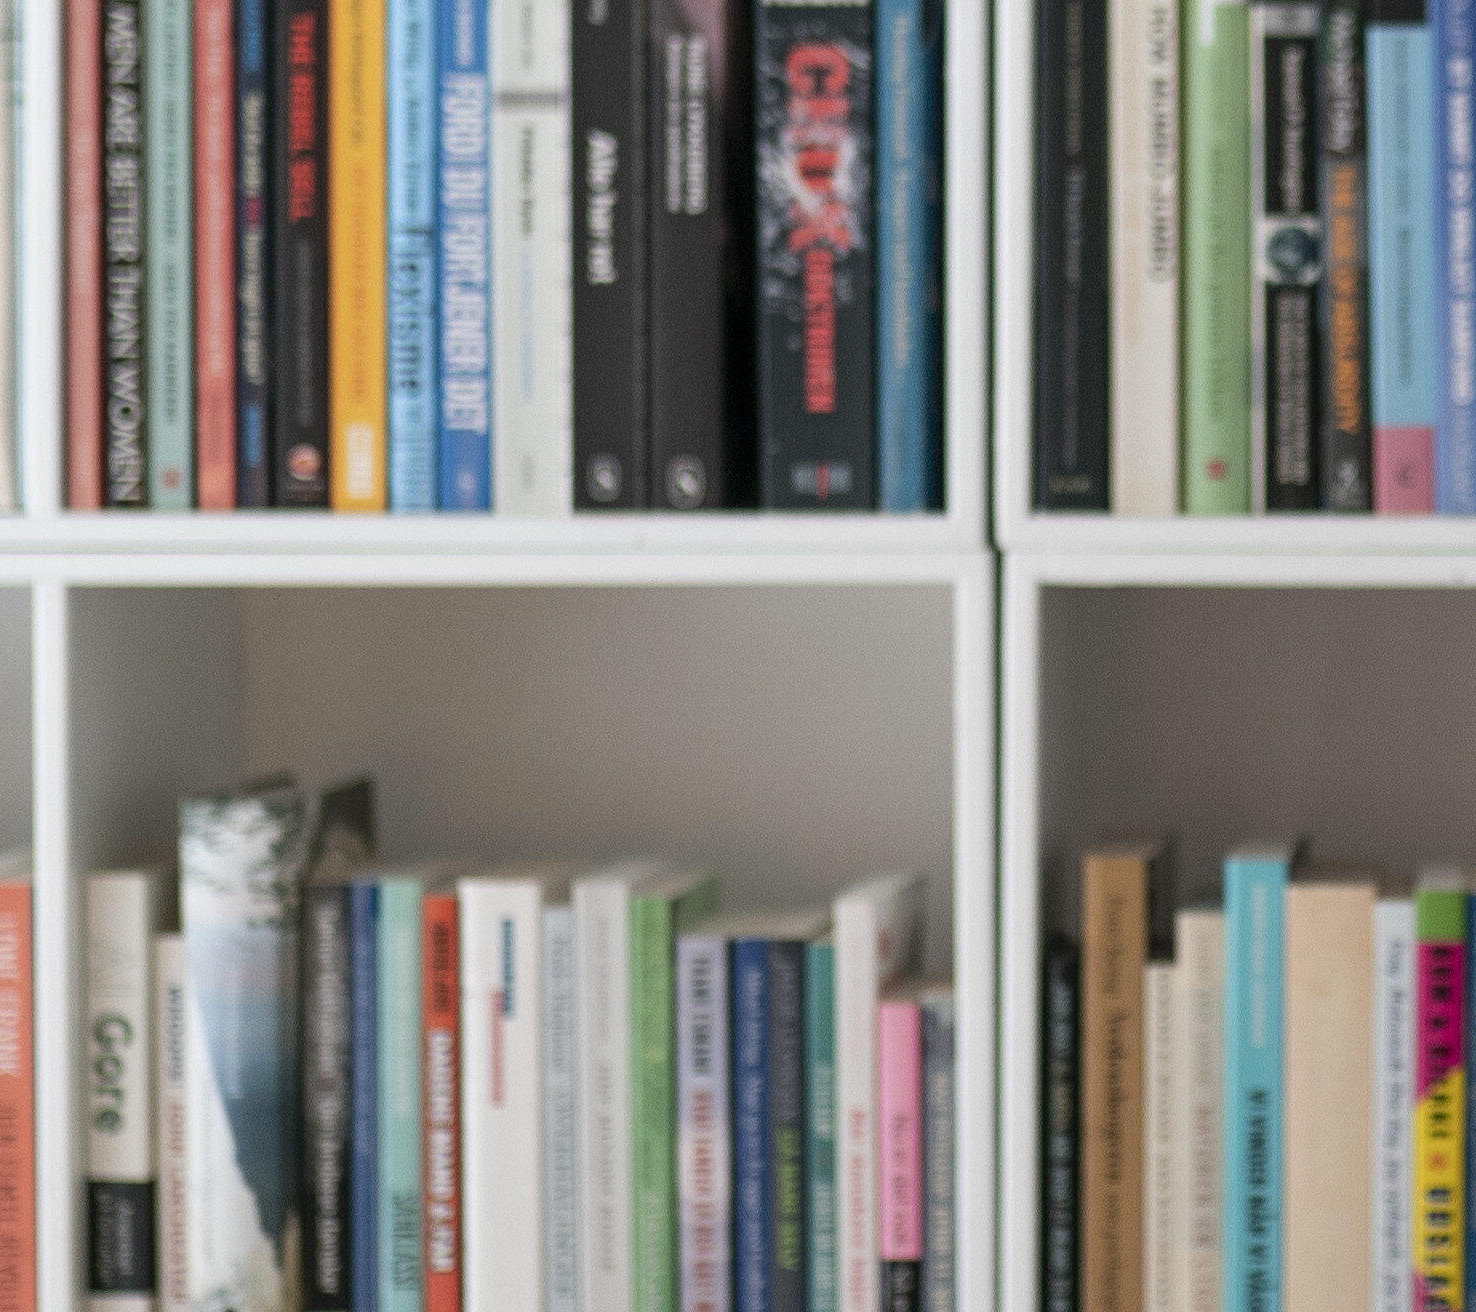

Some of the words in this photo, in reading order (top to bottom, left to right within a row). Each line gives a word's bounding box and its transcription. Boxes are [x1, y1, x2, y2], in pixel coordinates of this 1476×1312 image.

[107, 93, 135, 151] ARE
[107, 157, 136, 259] BETTER
[108, 266, 137, 360] THAN
[108, 364, 138, 502] WOMEN
[92, 1012, 134, 1137] Gore
